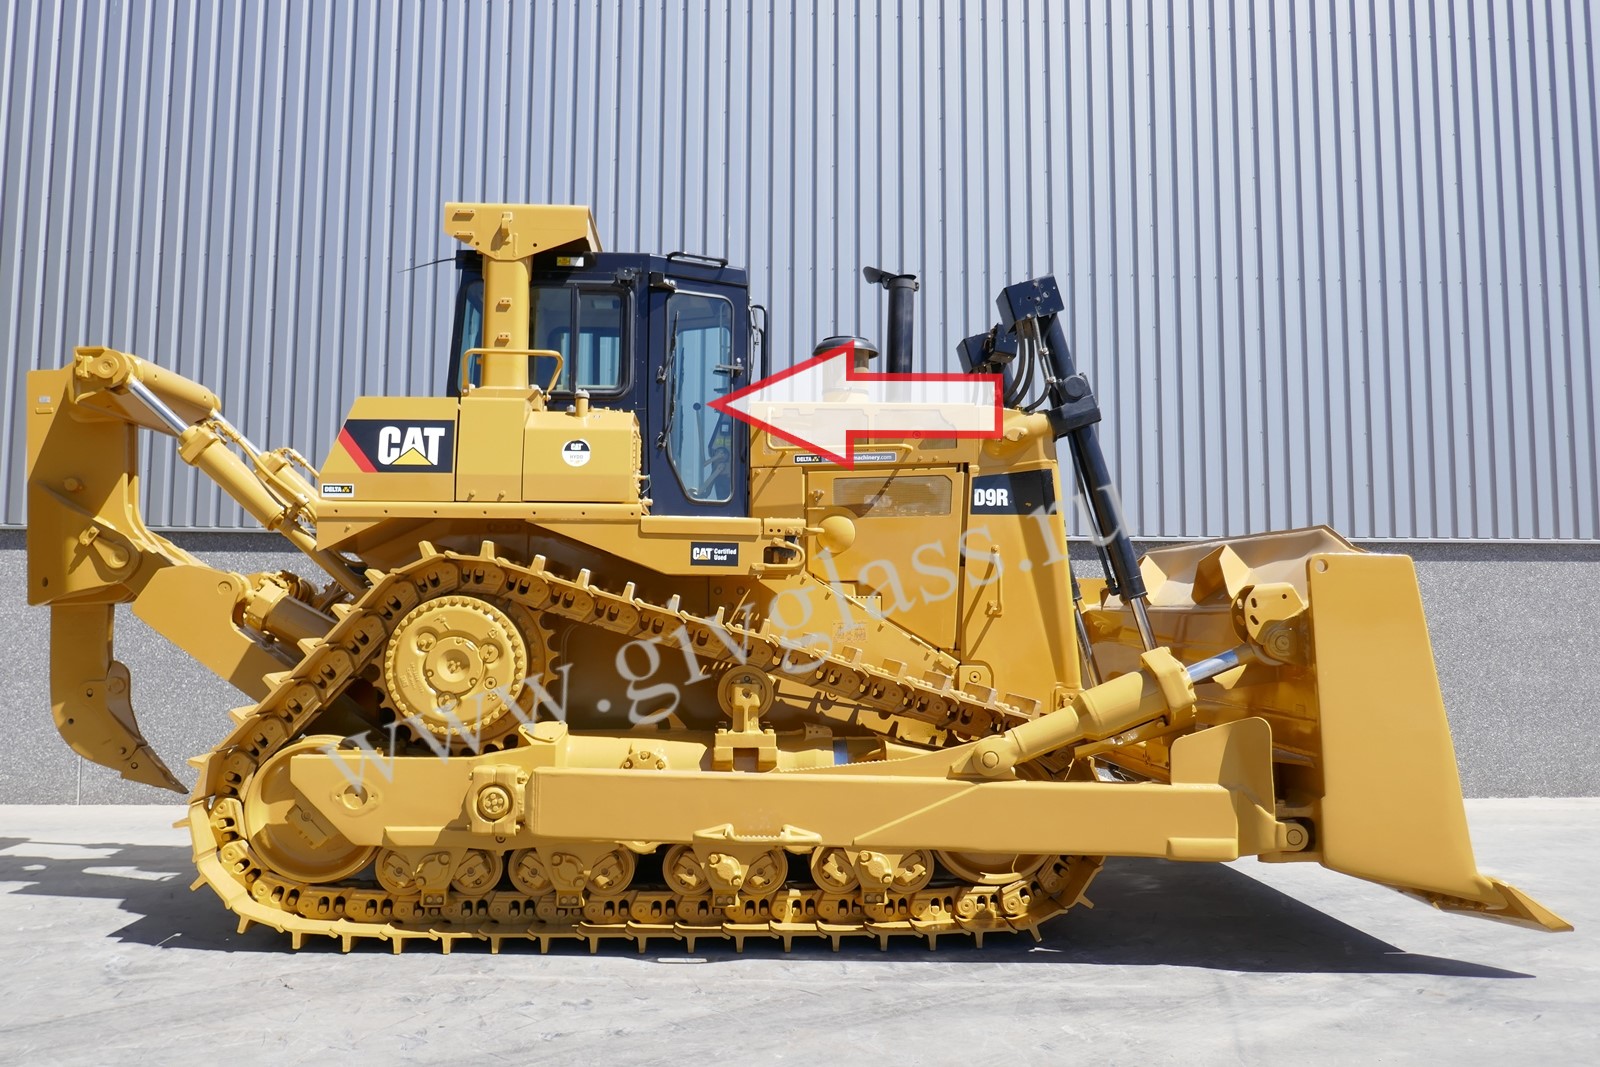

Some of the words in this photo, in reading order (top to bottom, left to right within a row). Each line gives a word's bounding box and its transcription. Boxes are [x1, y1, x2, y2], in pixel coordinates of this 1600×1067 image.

[378, 426, 445, 465] CAT
[974, 488, 1008, 506] D9R
[693, 547, 712, 560] CAT
